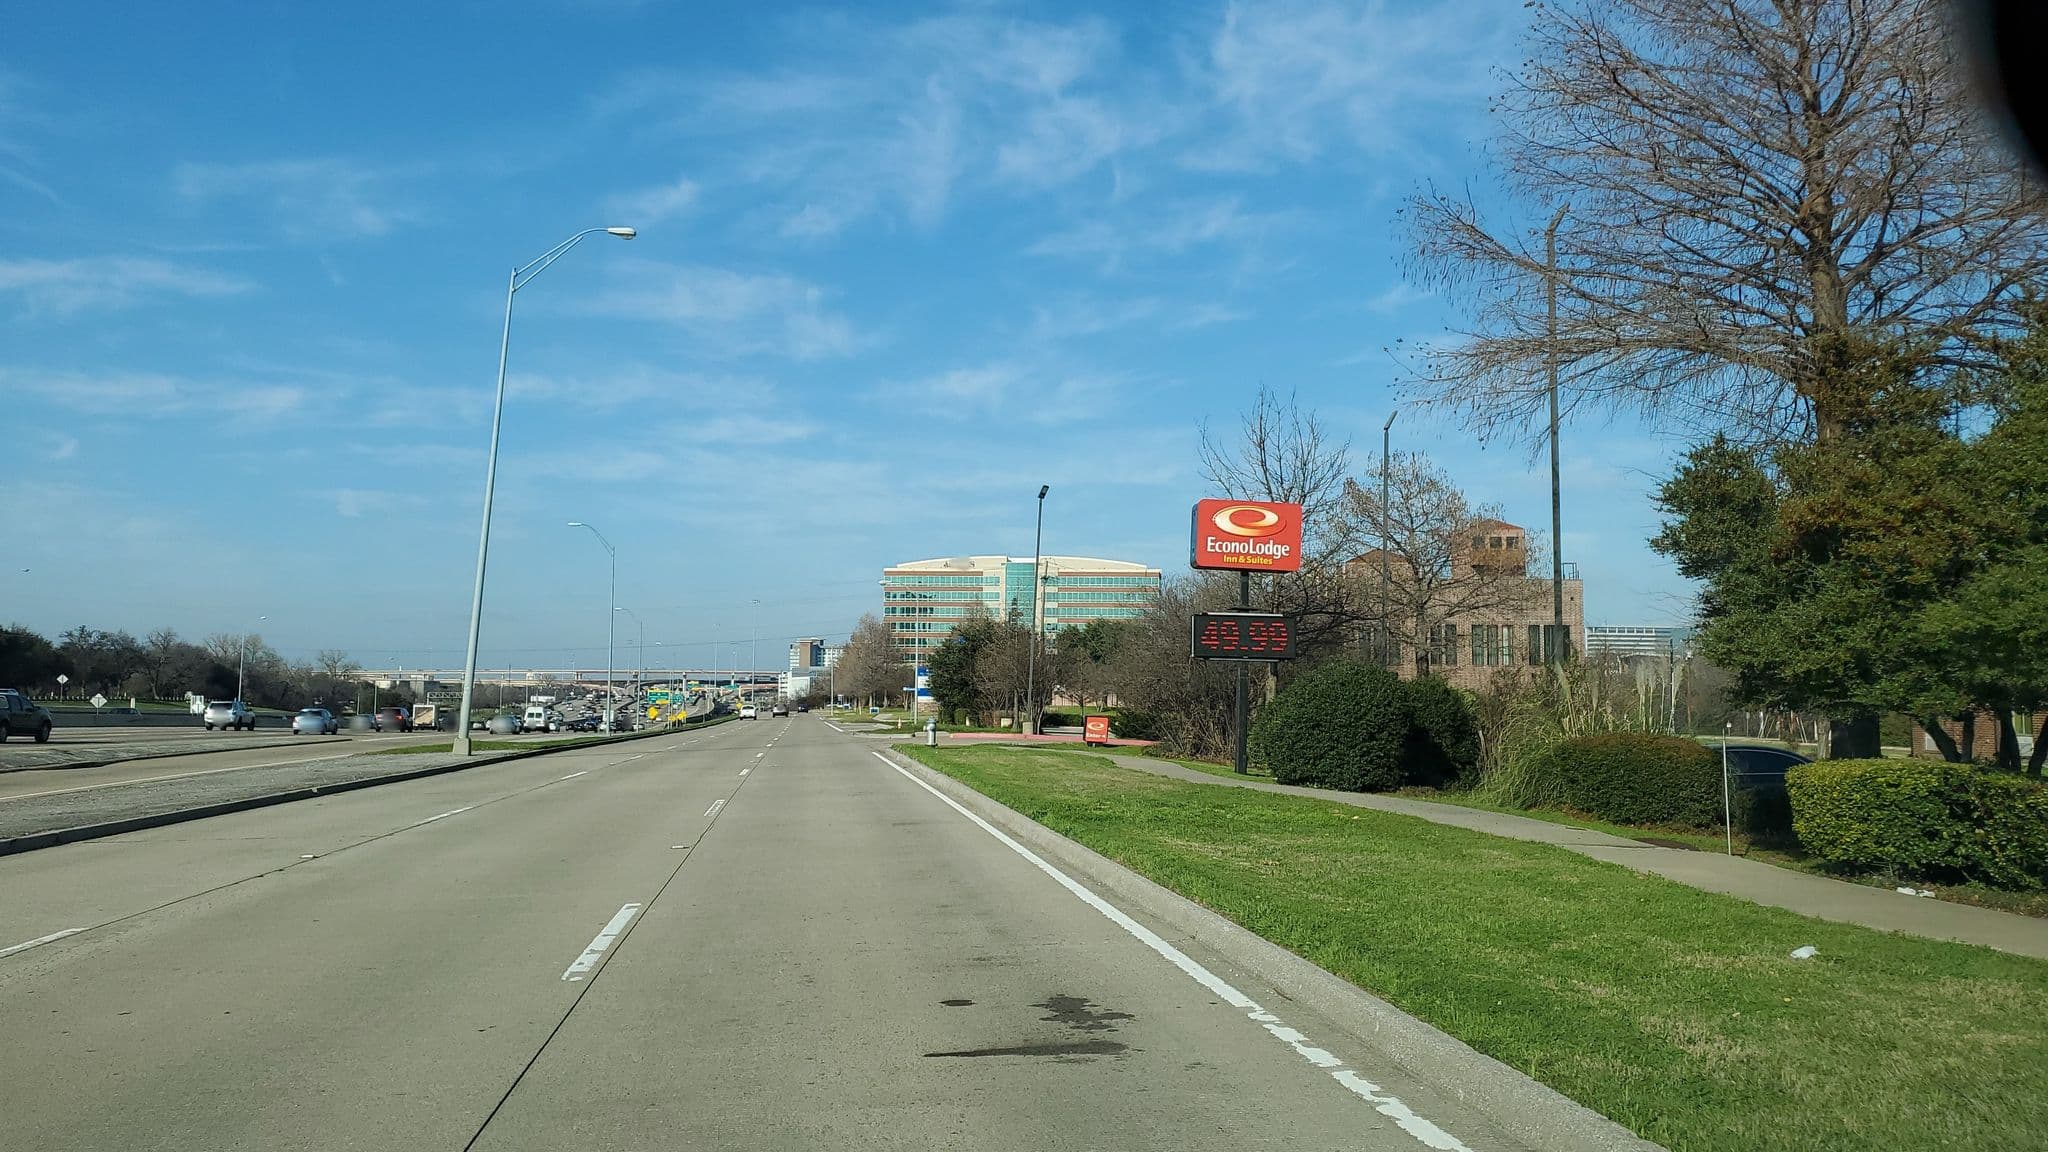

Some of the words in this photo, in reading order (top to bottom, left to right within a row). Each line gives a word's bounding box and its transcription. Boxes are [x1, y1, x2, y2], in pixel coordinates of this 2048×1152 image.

[1207, 536, 1290, 559] EconoLodge
[1223, 555, 1238, 563] Inn
[1246, 556, 1273, 565] Suites
[1201, 621, 1288, 651] 49.99
